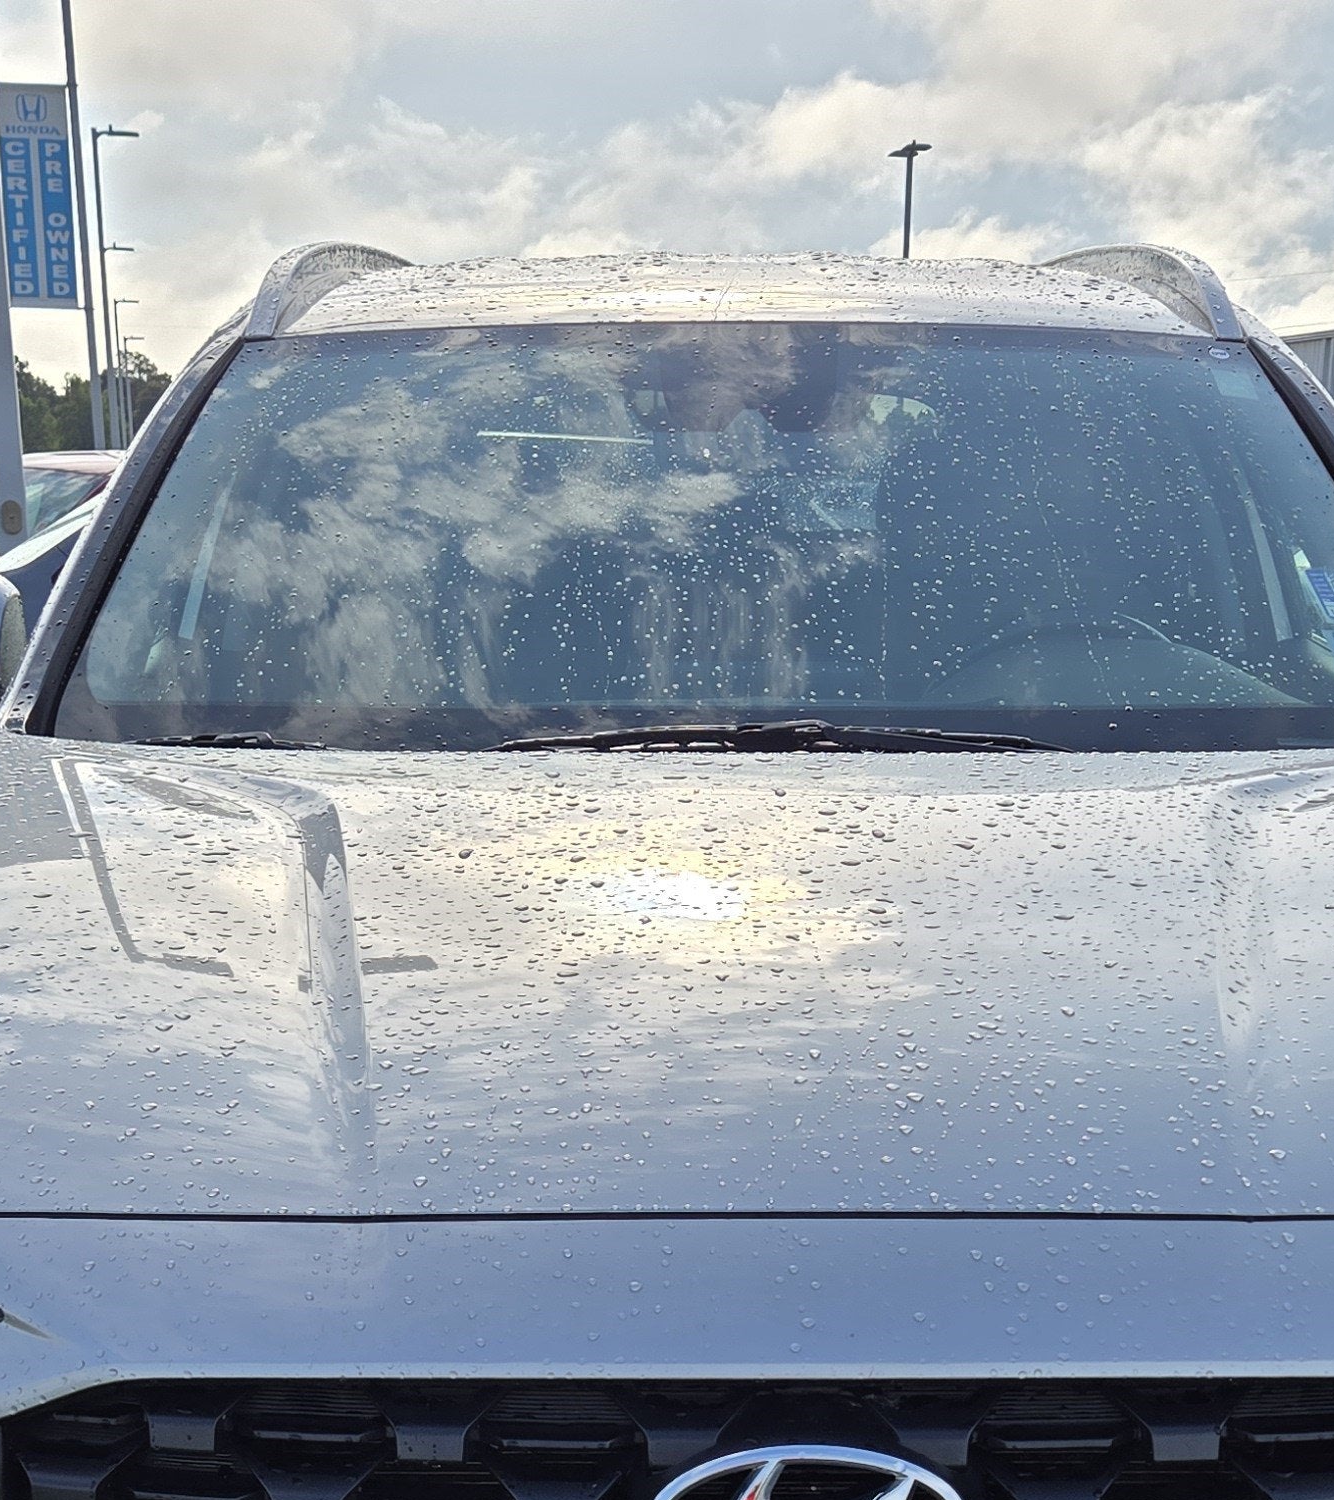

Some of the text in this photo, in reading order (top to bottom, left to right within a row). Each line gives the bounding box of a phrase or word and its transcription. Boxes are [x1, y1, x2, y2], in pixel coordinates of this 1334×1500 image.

[5, 124, 61, 136] HONDA
[4, 141, 35, 295] CERTIFIED
[44, 142, 70, 296] PRE OWNED
